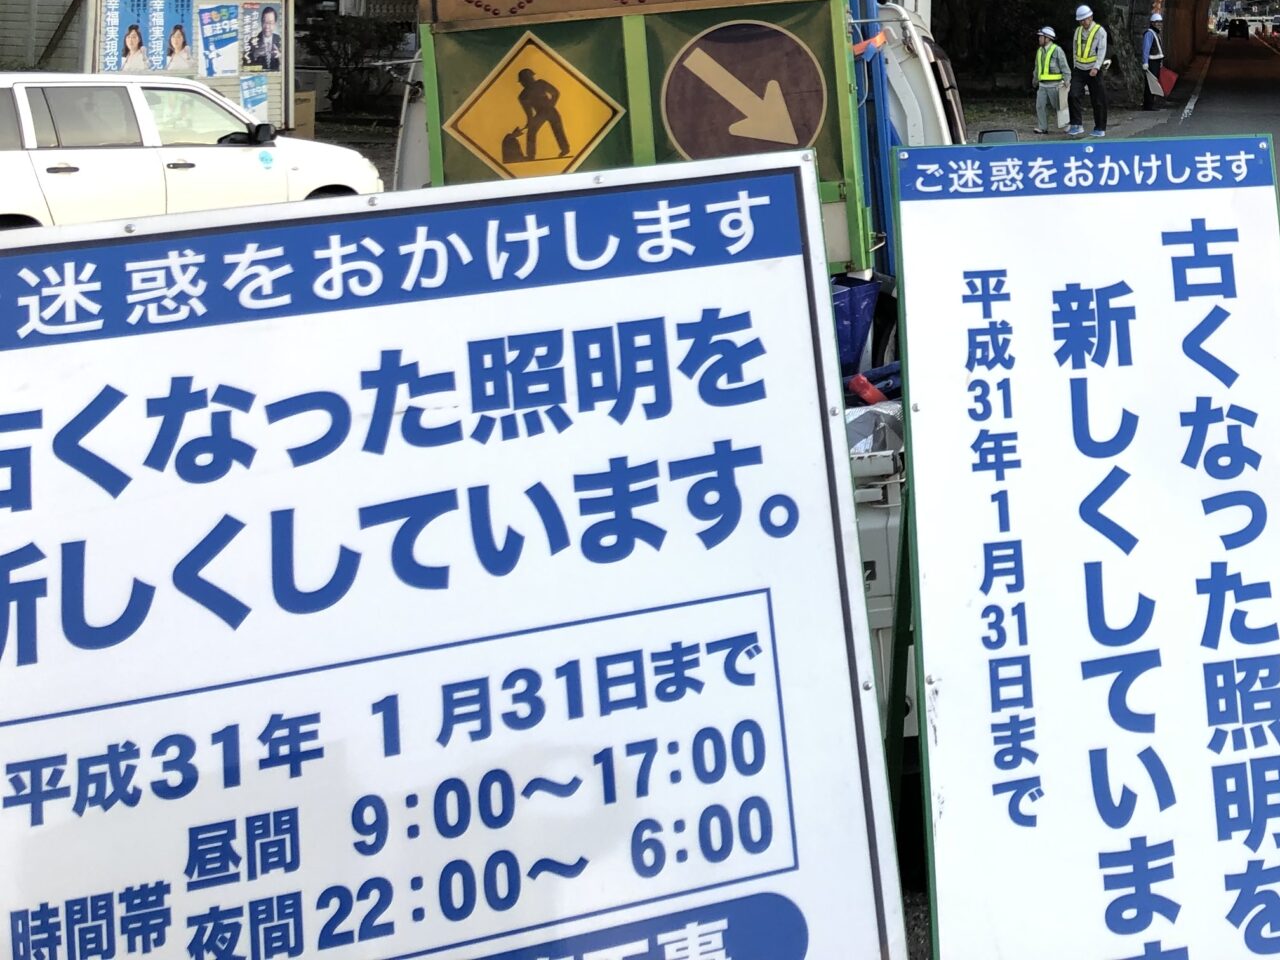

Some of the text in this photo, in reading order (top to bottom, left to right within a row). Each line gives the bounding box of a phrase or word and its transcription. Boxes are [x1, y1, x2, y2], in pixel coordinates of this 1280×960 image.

[916, 151, 1255, 192] ご迷惑をおかけします
[17, 191, 769, 338] 迷惑をおかけします
[963, 270, 1040, 827] 平成31年1月31日まで
[1053, 282, 1188, 960] 新しくしていま
[11, 881, 171, 960] 時間帯
